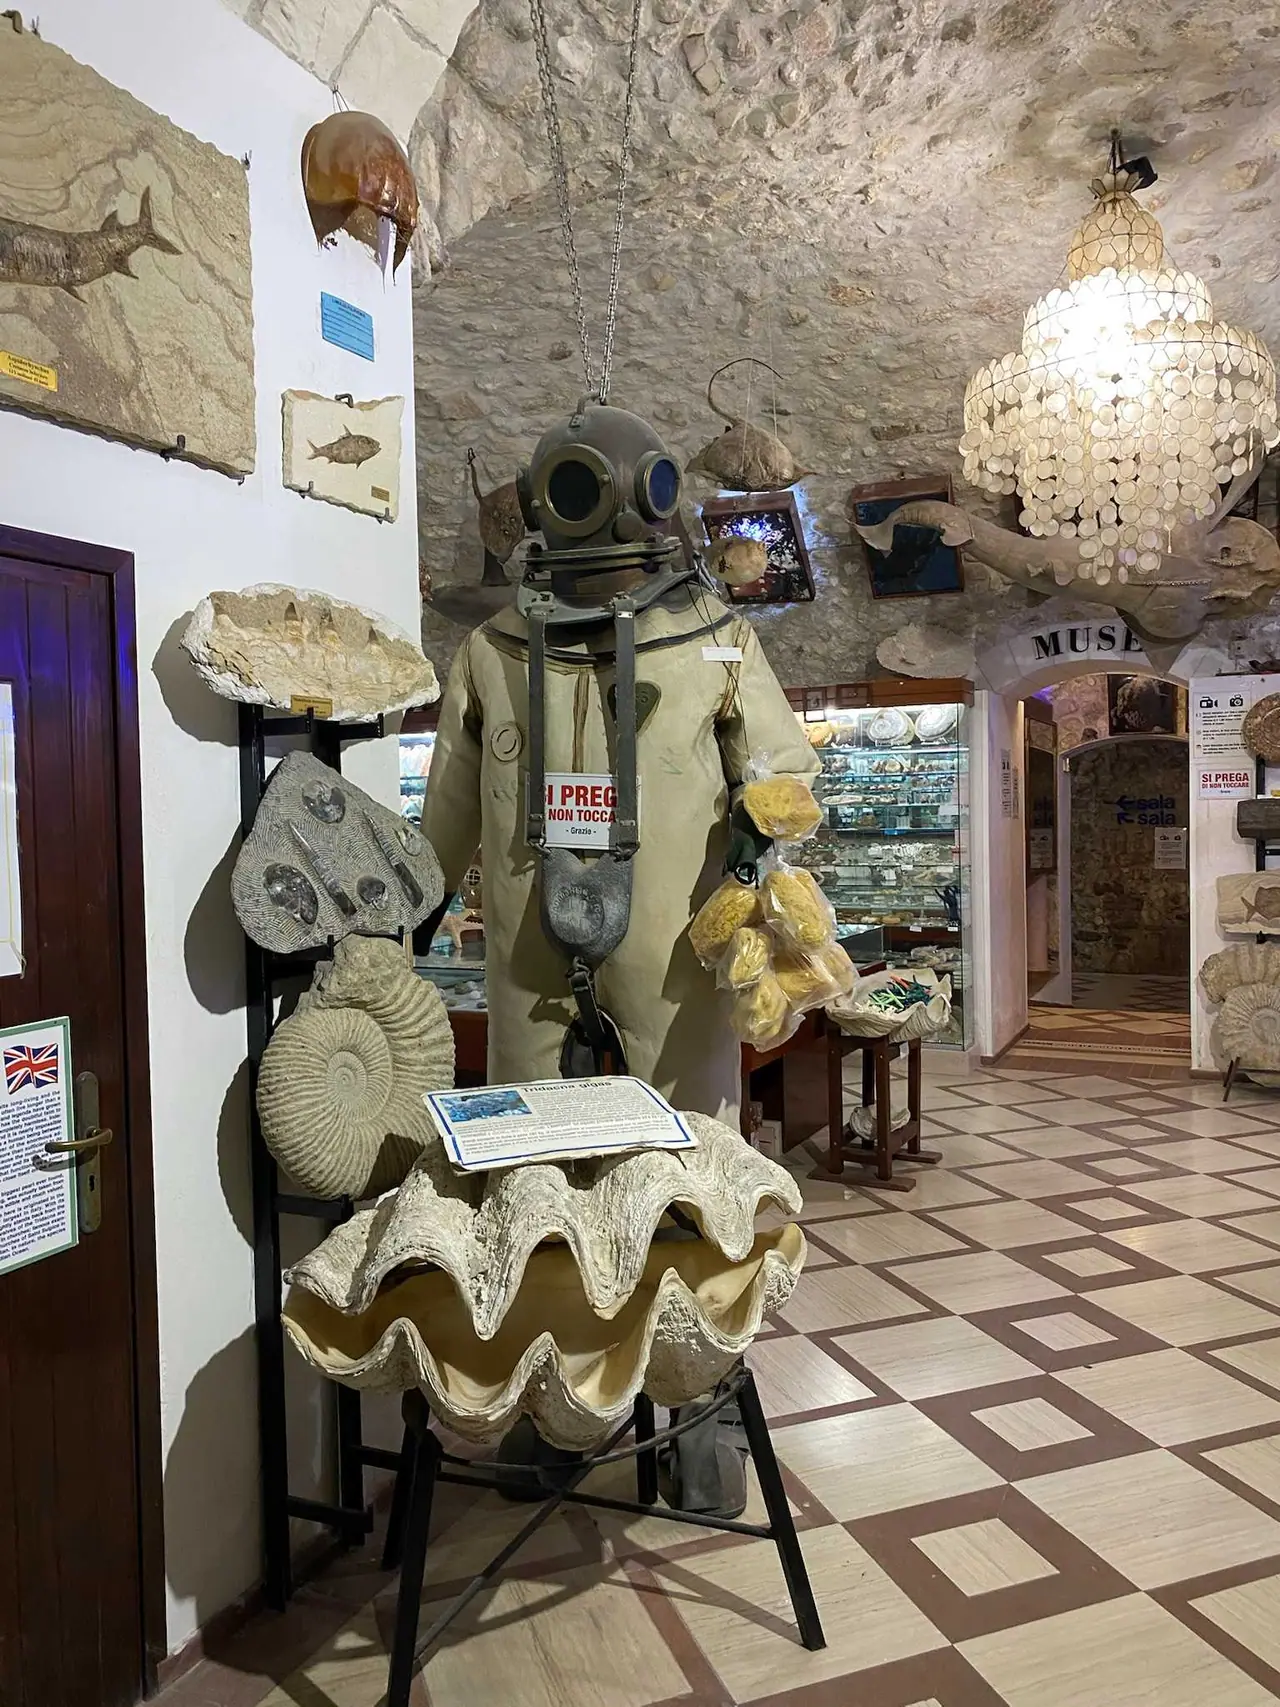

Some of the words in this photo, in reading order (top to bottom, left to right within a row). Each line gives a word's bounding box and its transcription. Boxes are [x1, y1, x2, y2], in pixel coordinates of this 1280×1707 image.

[1202, 774, 1212, 782] SI
[1215, 772, 1249, 782] PREGA
[561, 785, 618, 808] PREG
[1136, 794, 1176, 810] sala
[548, 808, 573, 822] NON
[577, 810, 616, 823] TOCCA
[1138, 810, 1176, 825] sala
